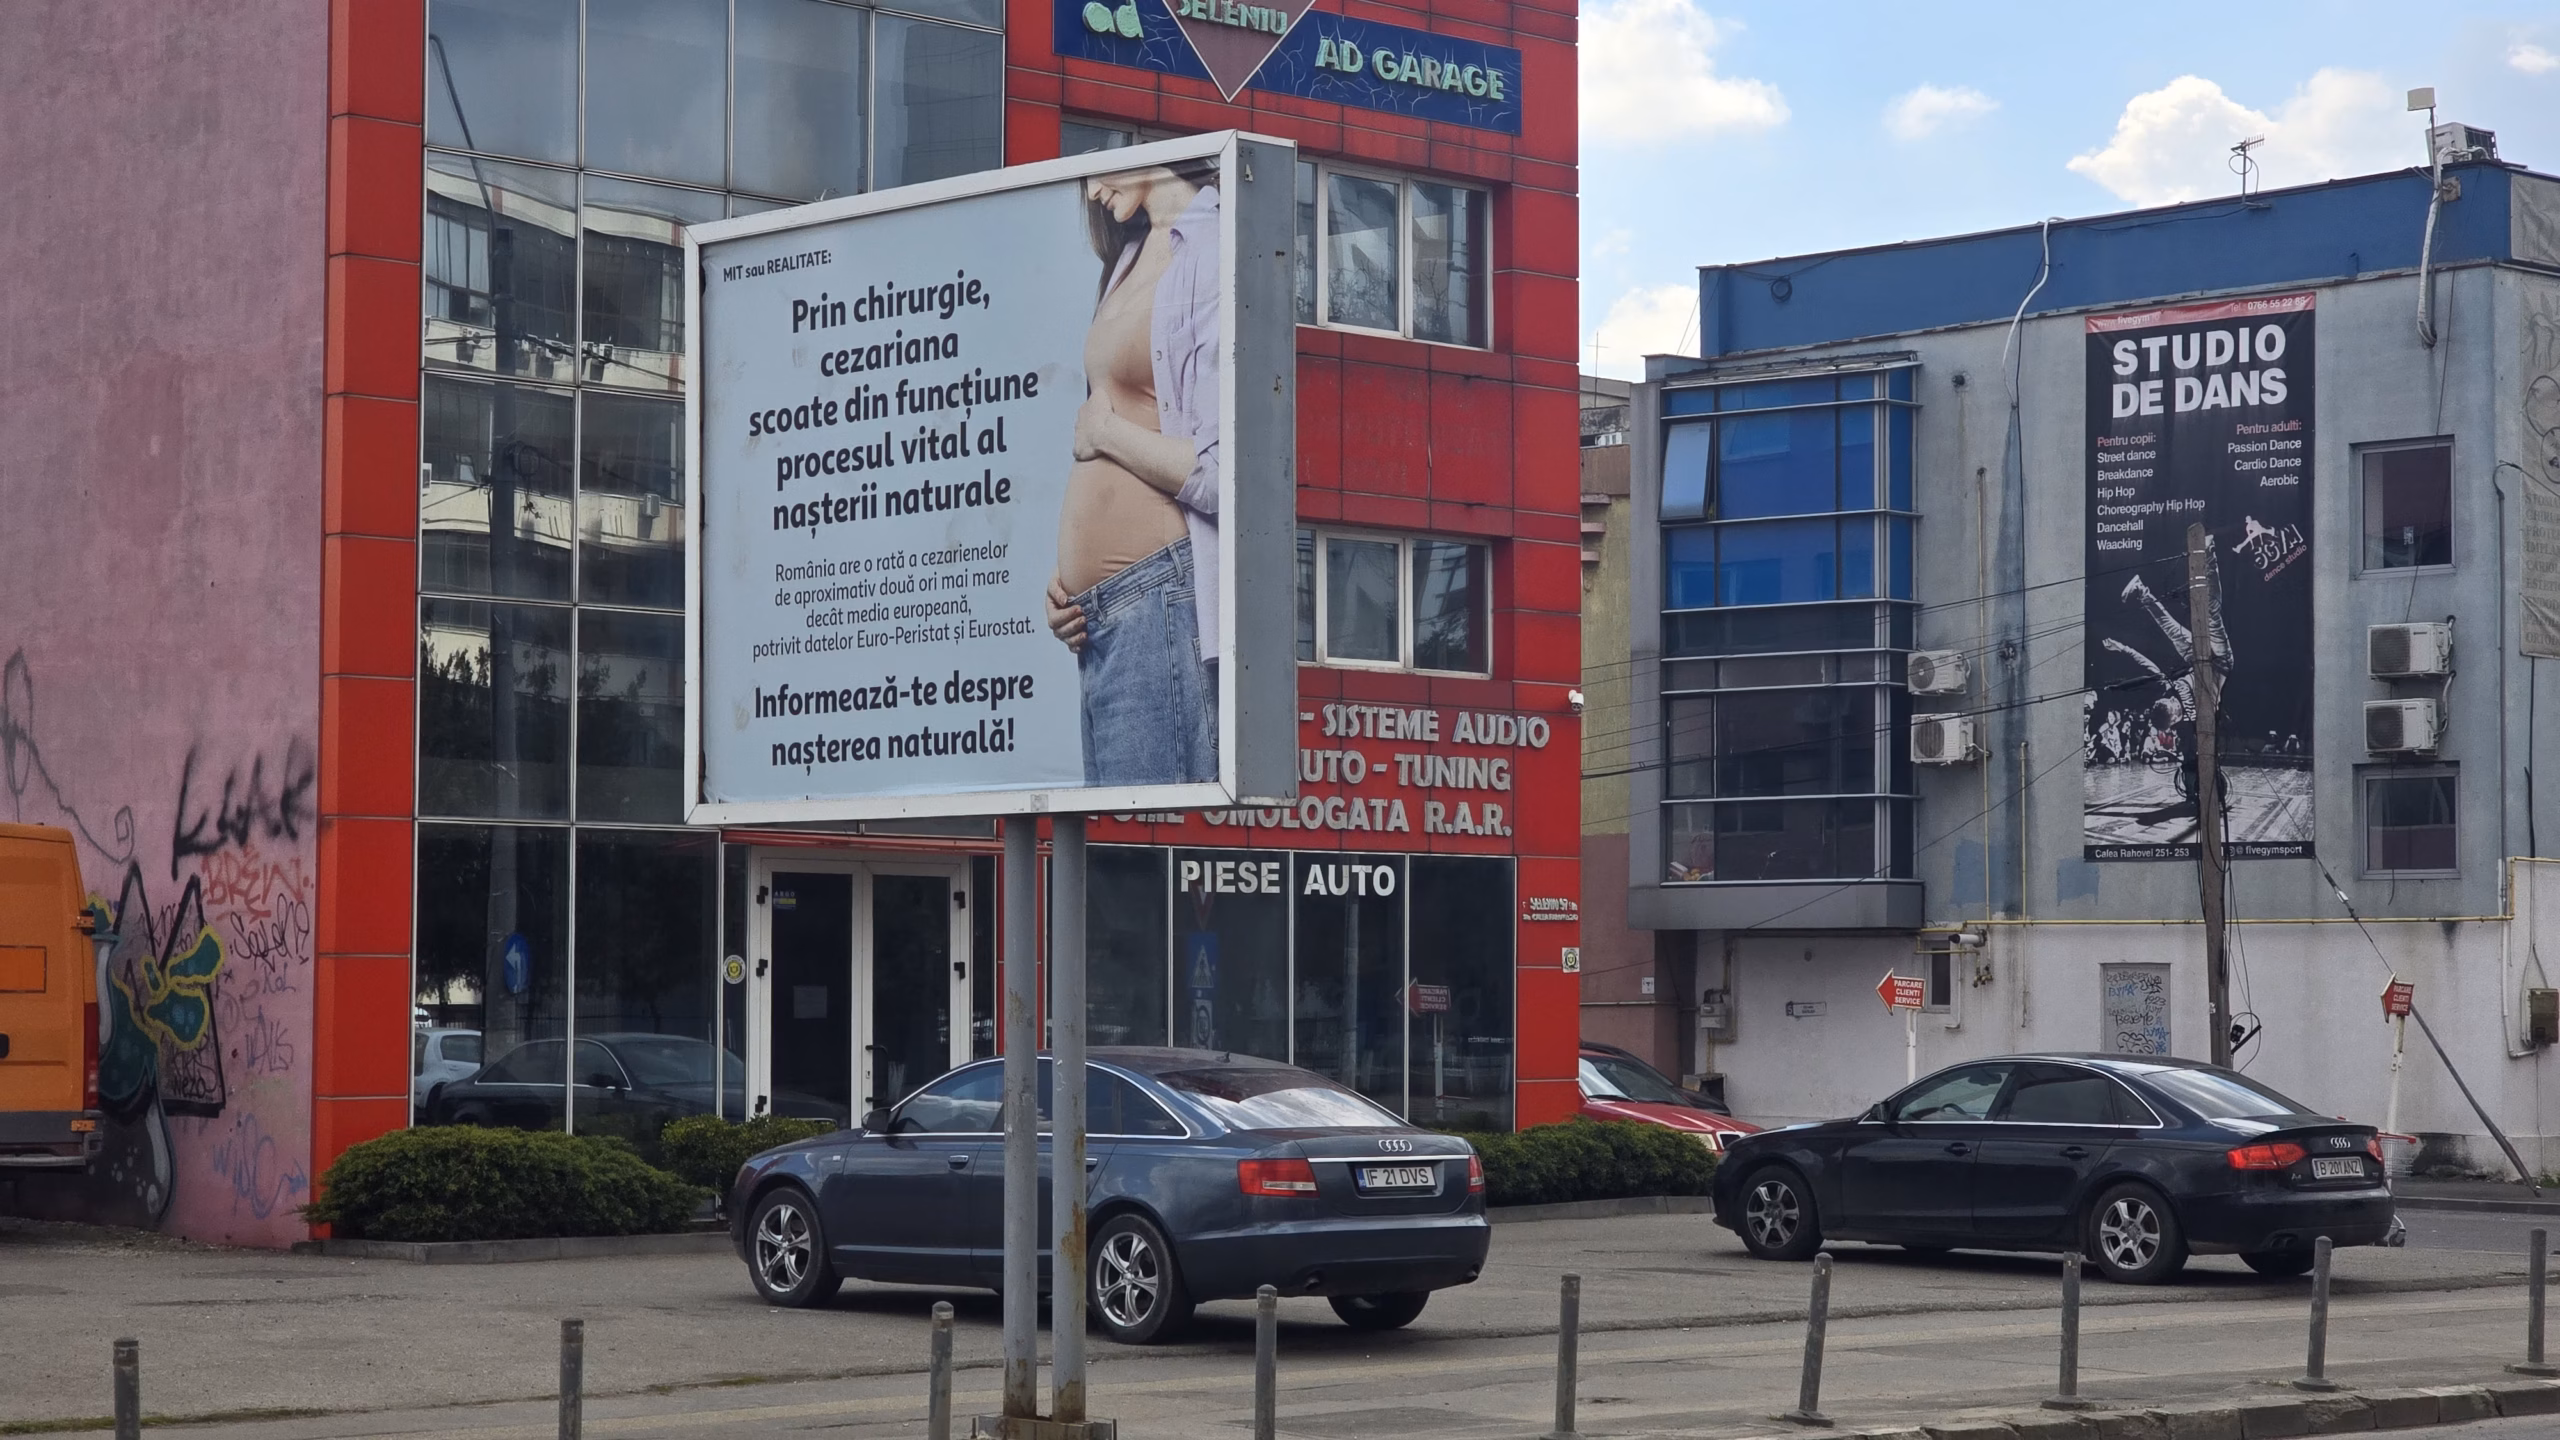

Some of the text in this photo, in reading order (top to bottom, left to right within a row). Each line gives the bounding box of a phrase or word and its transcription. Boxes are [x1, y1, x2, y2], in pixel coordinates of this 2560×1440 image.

[1082, 0, 1144, 38] ad
[1314, 37, 1505, 100] AD GARAGE
[723, 250, 832, 282] MIT sau REALITATE:
[792, 269, 990, 333] Prin chirurgie,
[2247, 300, 2268, 311] 0766
[2269, 299, 2280, 308] 55
[2282, 298, 2293, 308] 22
[820, 329, 959, 377] cezariana
[2112, 324, 2286, 376] STUDIO
[749, 367, 1039, 437] scoate din funcțiune
[2112, 368, 2288, 419] DE DANS
[2097, 432, 2156, 449] Pentru copii:
[2236, 421, 2269, 435] Pentru
[777, 416, 1007, 491] procesul vital al
[2097, 448, 2156, 464] Street dance
[2228, 438, 2302, 454] Passion Dance
[2097, 467, 2154, 481] Breakdance
[2234, 456, 2302, 471] Cardio Dance
[2097, 485, 2135, 500] Hip Hop
[2259, 474, 2299, 488] Aerobic
[773, 468, 1011, 539] nașterii naturale
[2097, 498, 2205, 517] Choreography Hip Hop
[2097, 519, 2143, 533] Dancehall
[2096, 537, 2143, 551] Waacking
[775, 540, 1008, 583] România are o rată a cezarienelor
[2264, 545, 2307, 582] dance studio
[774, 568, 1010, 609] de aproximativ două ori mai mare
[806, 595, 972, 628] decât media europeană,
[753, 616, 1036, 663] potrivit datelor Euro-Peristat și Eurostat.
[755, 670, 1034, 719] Informează-te despre
[1322, 703, 1439, 742] SISTEME
[1452, 711, 1550, 748] AUDIO
[771, 717, 1015, 777] nașterea naturală!
[1297, 748, 1366, 784] UTO
[1394, 753, 1511, 791] TUNING
[1424, 800, 1512, 837] R.A.R.
[2174, 848, 2190, 857] 253
[2246, 845, 2303, 857] fivegymsport
[1180, 860, 1396, 897] PIESE AUTO
[1894, 980, 1923, 988] PARCARE
[1896, 988, 1920, 996] CLIENTI
[1895, 997, 1921, 1005] SERVICE
[1365, 1169, 1378, 1186] IF
[1383, 1169, 1397, 1185] 21
[1399, 1168, 1429, 1185] DVS
[2320, 1161, 2327, 1175] B
